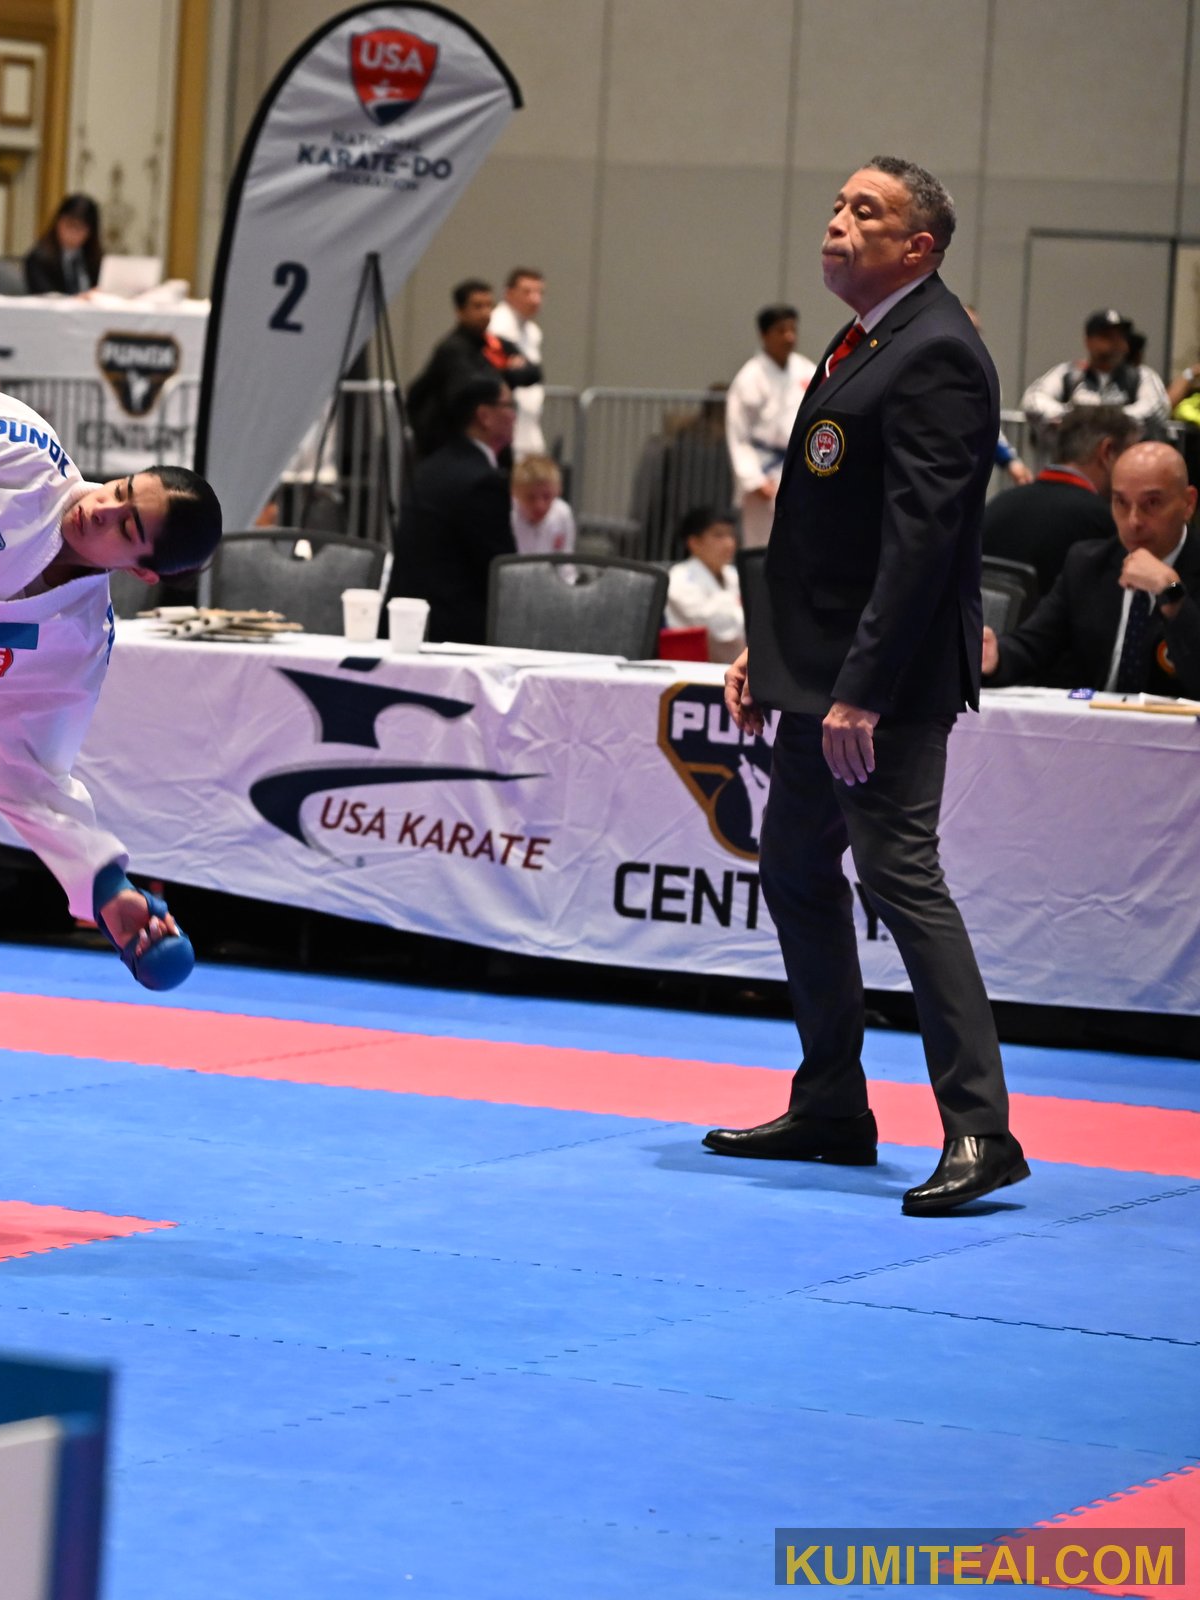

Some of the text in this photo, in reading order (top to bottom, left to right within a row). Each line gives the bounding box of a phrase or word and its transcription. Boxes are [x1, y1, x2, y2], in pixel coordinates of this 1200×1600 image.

[359, 41, 426, 75] USA
[297, 144, 453, 180] KARATE-DO
[268, 261, 309, 332] 2
[671, 701, 782, 747] PUN
[320, 797, 551, 870] USA KARATE
